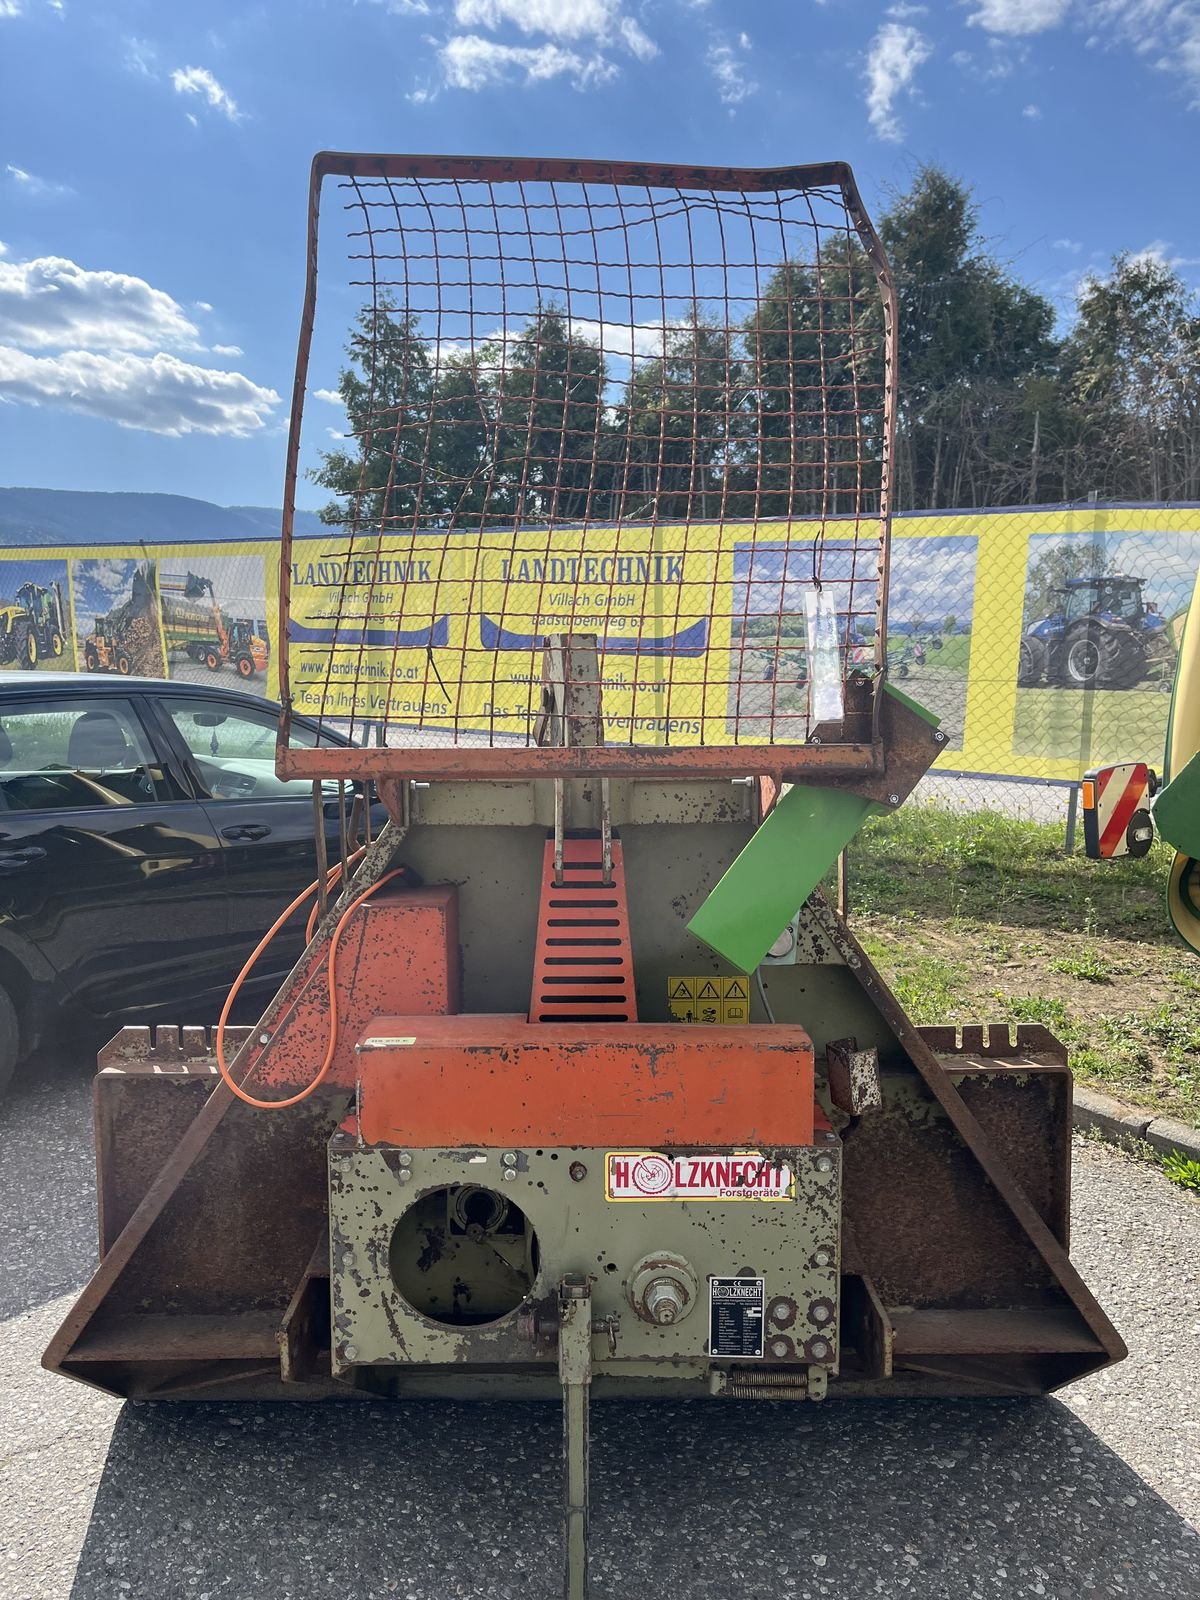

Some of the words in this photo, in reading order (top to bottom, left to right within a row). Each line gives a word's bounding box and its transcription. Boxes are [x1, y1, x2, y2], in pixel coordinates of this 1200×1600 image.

[292, 560, 432, 586] LANDTECHNIK
[501, 556, 685, 584] LANDTECHNIK
[329, 591, 360, 604] Villach
[362, 592, 394, 605] GmbH
[548, 593, 590, 607] Villach
[593, 593, 636, 608] GmbH
[300, 689, 335, 706] Team
[337, 691, 367, 708] Ihres
[370, 694, 448, 715] Vertrauens
[482, 702, 509, 720] Das
[514, 704, 539, 721] Tea
[719, 1187, 780, 1199] Forstgeräte
[712, 1287, 762, 1298] HOLZKNECHT
